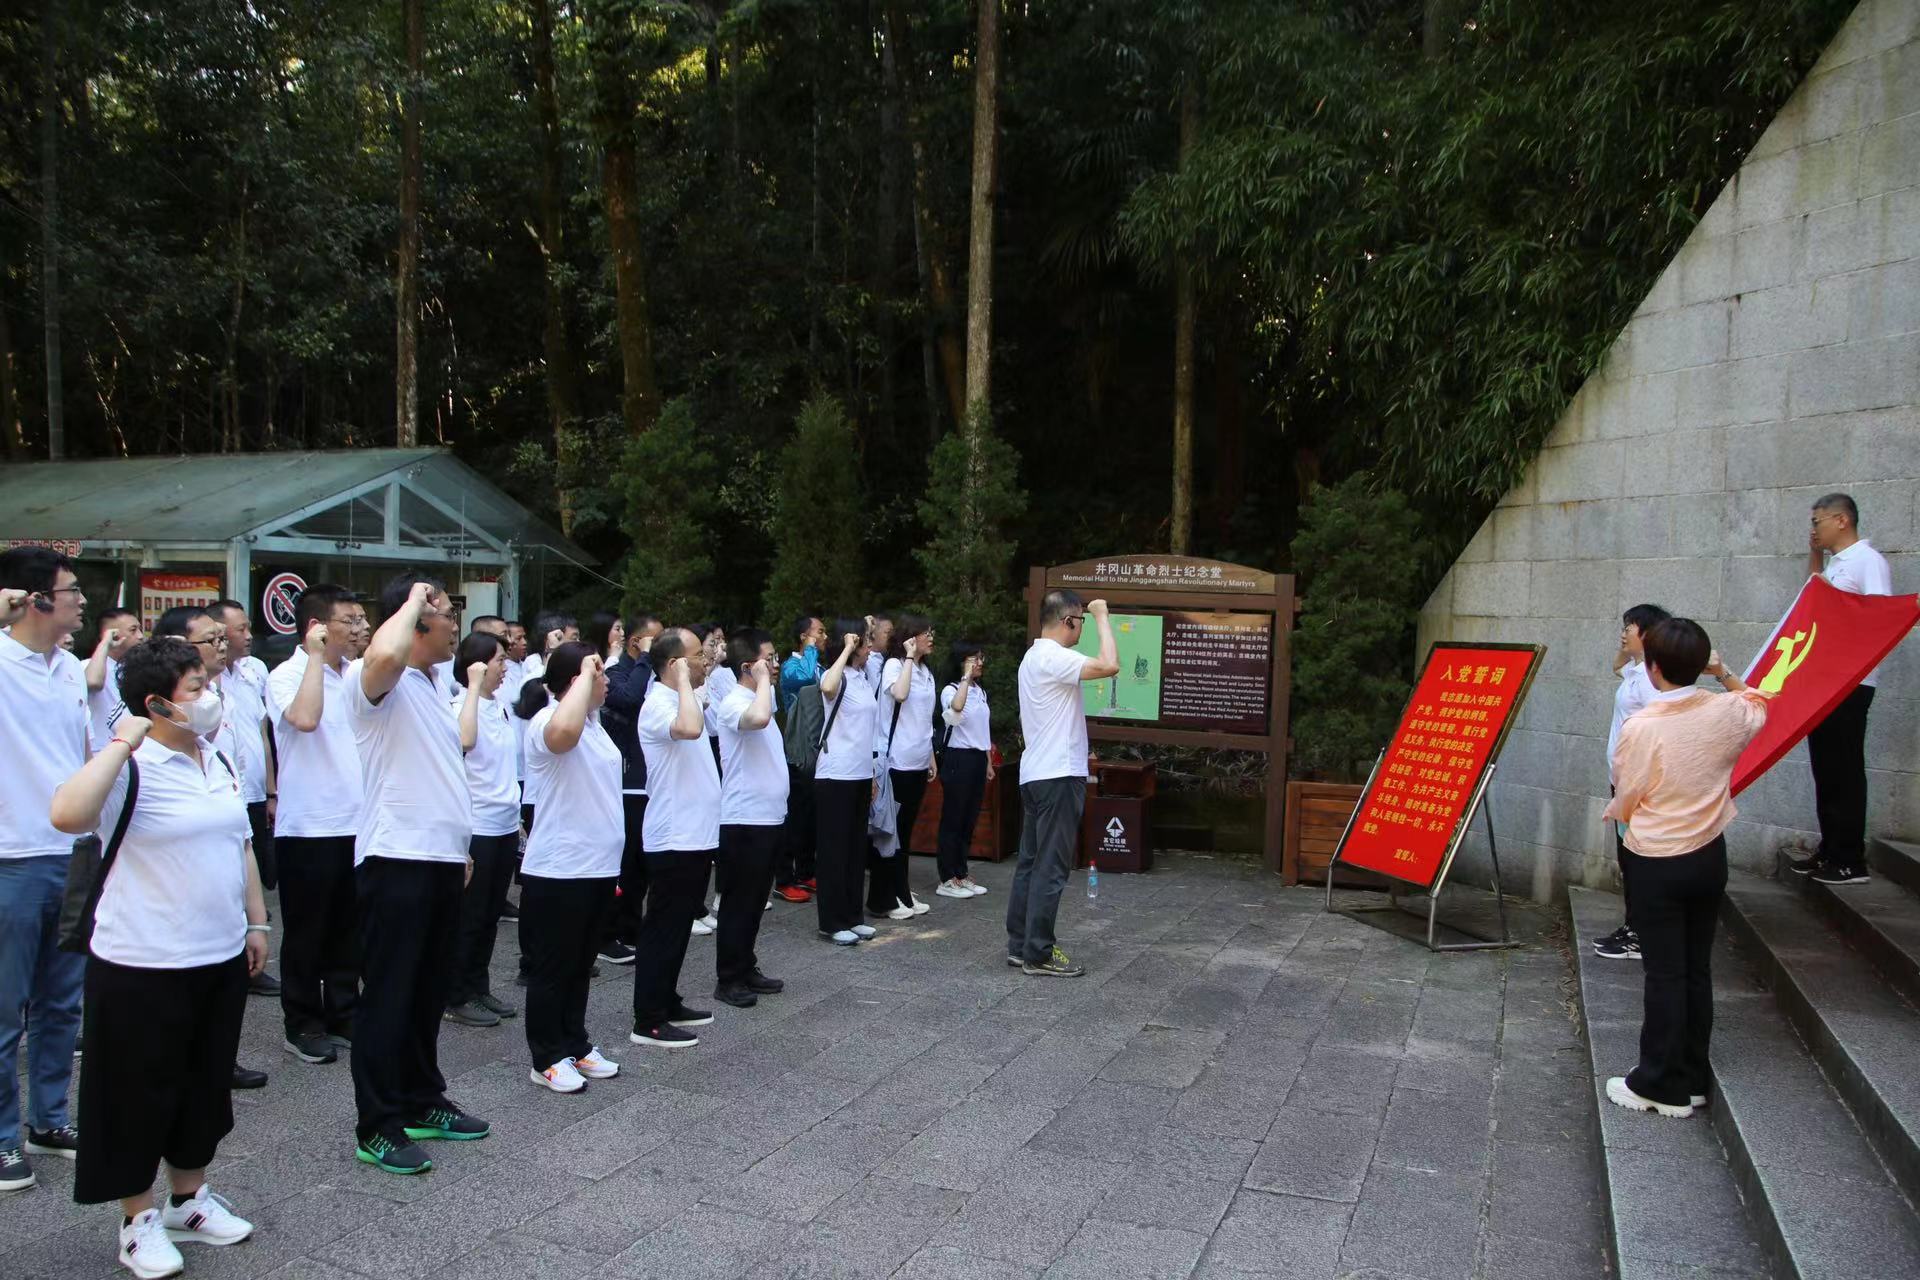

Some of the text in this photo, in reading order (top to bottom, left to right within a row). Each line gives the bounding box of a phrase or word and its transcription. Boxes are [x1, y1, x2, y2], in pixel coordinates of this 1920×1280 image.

[1095, 563, 1223, 579] 井冈山革命烈士纪念堂
[1062, 574, 1094, 582] Memorial
[1129, 577, 1178, 586] Jinggangshan
[1178, 579, 1227, 587] Revolutionary
[1228, 580, 1256, 588] Martyrs
[1440, 664, 1506, 685] 入党誓词
[1440, 691, 1502, 707] 我志愿加入中国共
